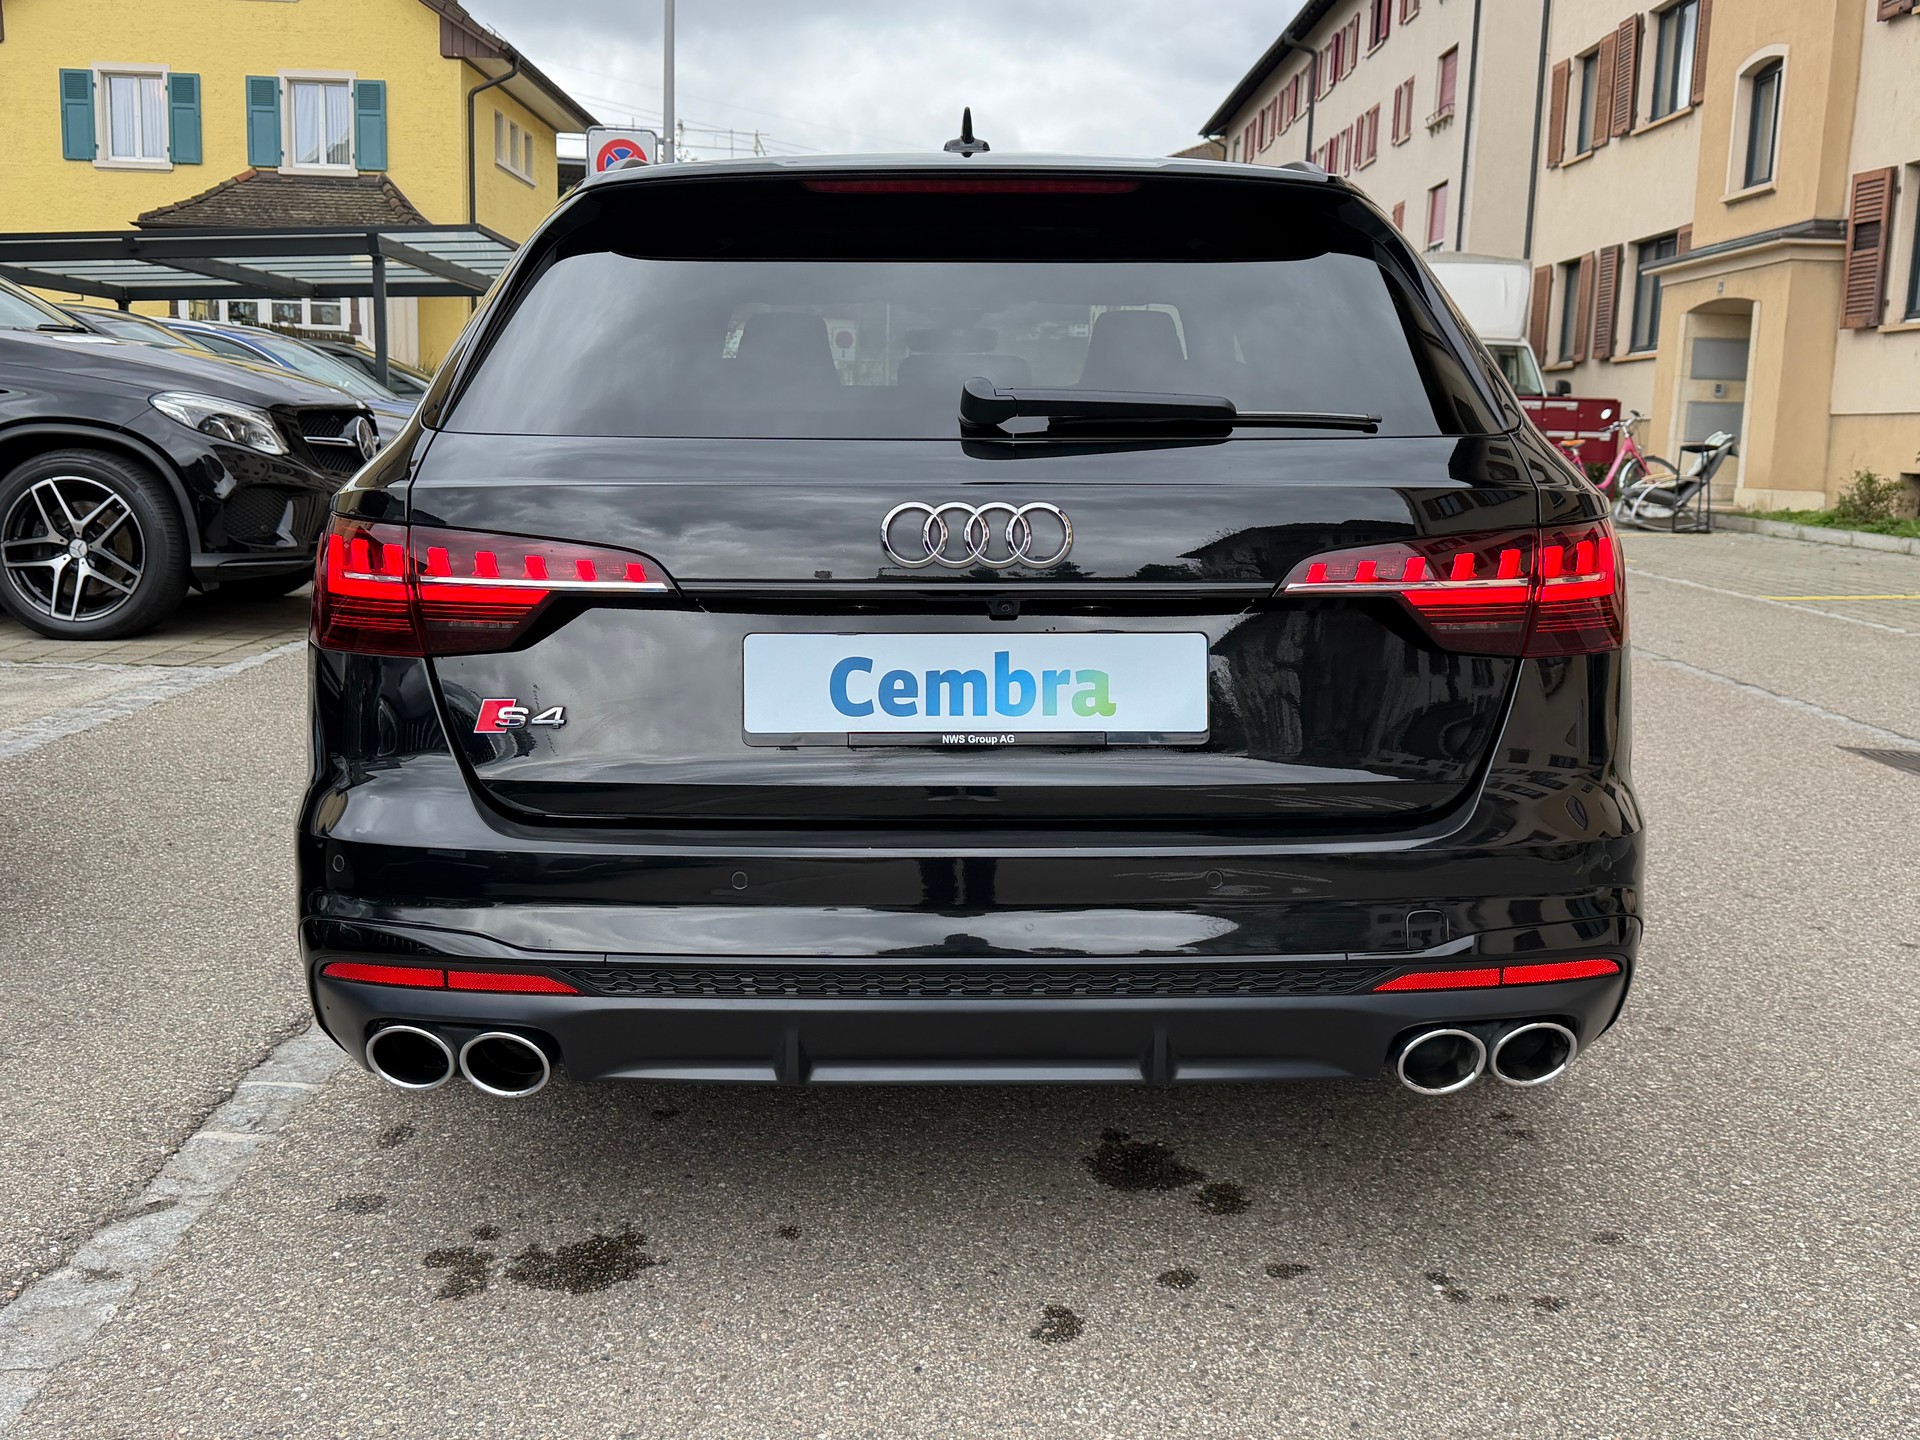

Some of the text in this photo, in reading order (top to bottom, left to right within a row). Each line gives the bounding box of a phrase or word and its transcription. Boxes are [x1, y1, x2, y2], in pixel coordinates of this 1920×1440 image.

[829, 651, 1117, 717] Cembra
[494, 705, 566, 729] S4
[942, 734, 1015, 745] NWS Group AG
